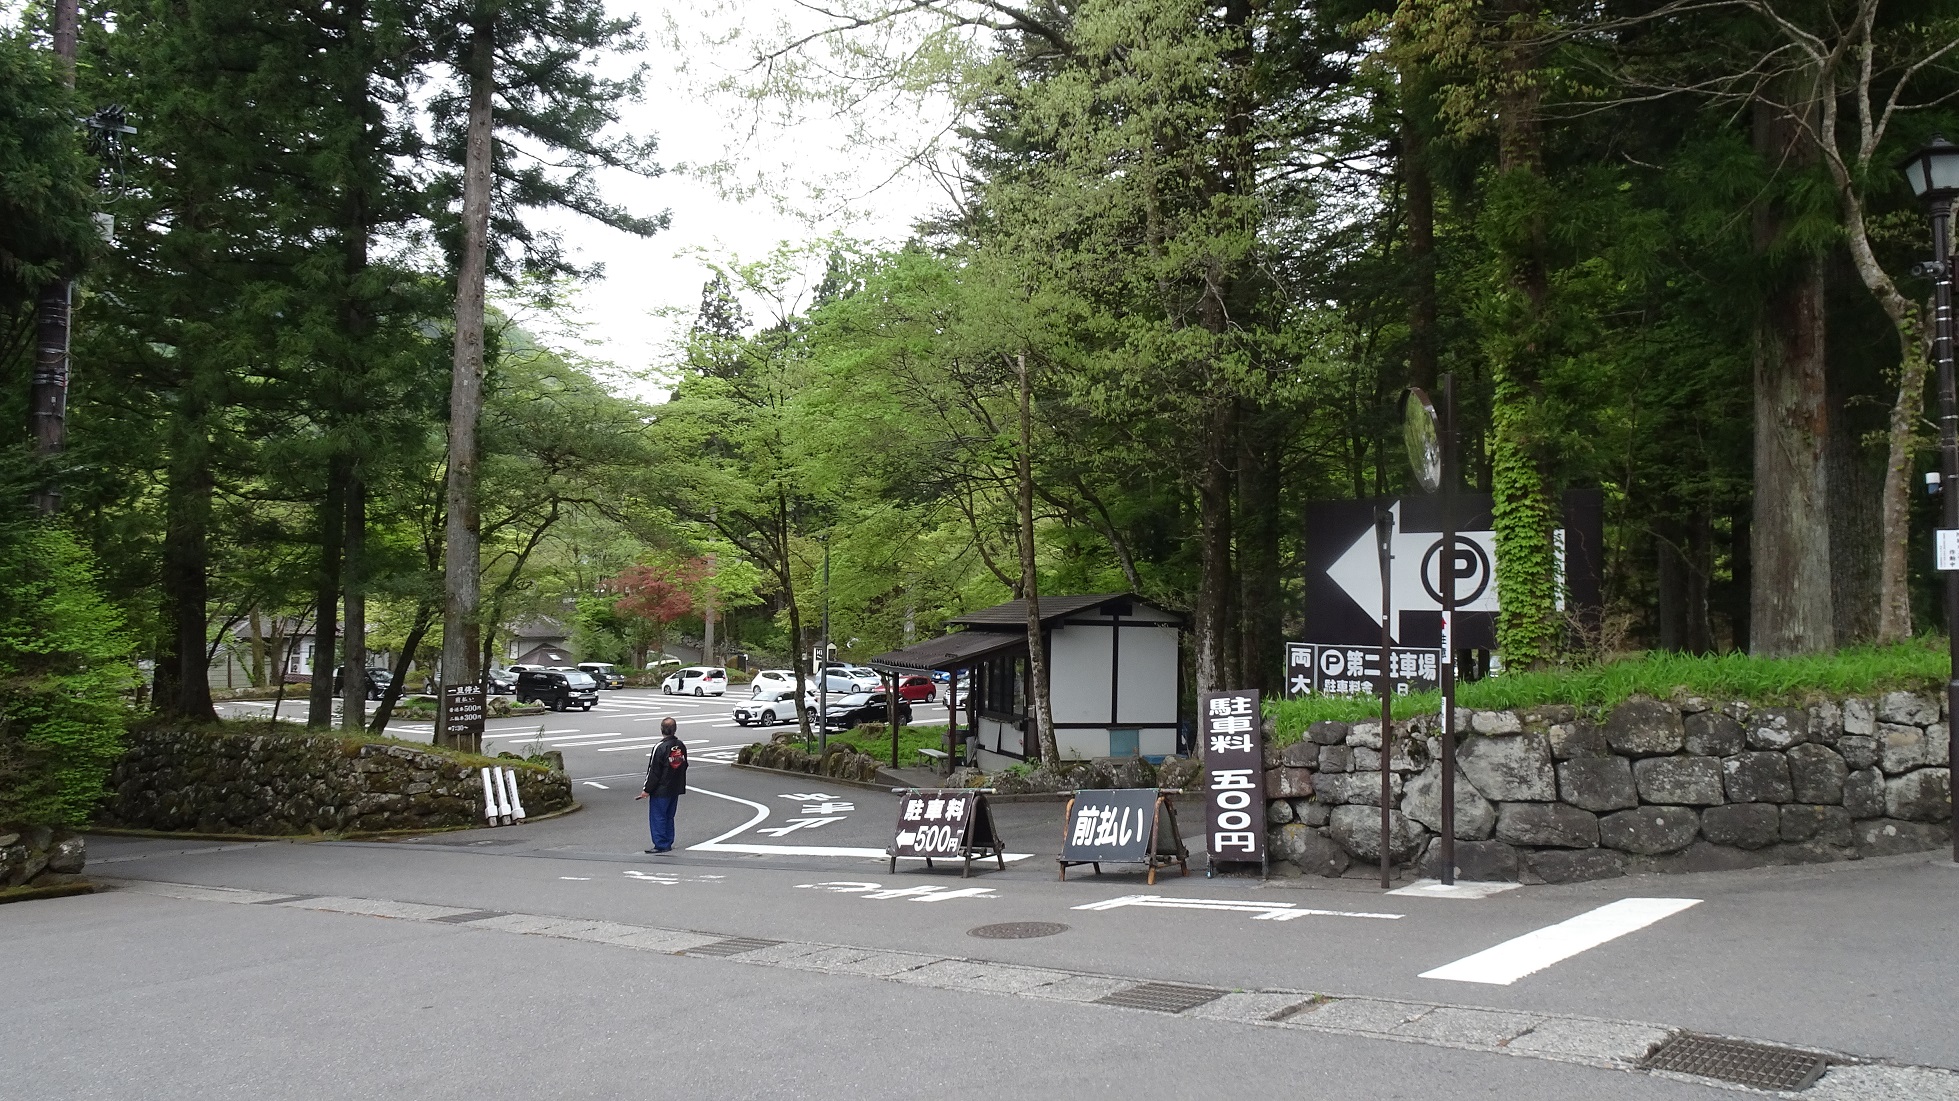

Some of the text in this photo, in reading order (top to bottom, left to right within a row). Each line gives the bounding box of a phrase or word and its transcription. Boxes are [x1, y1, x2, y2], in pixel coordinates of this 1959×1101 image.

[1208, 696, 1253, 754] 駐車料
[903, 797, 966, 822] 駐車料
[1071, 804, 1144, 848] 前払い
[913, 825, 959, 852] 500円
